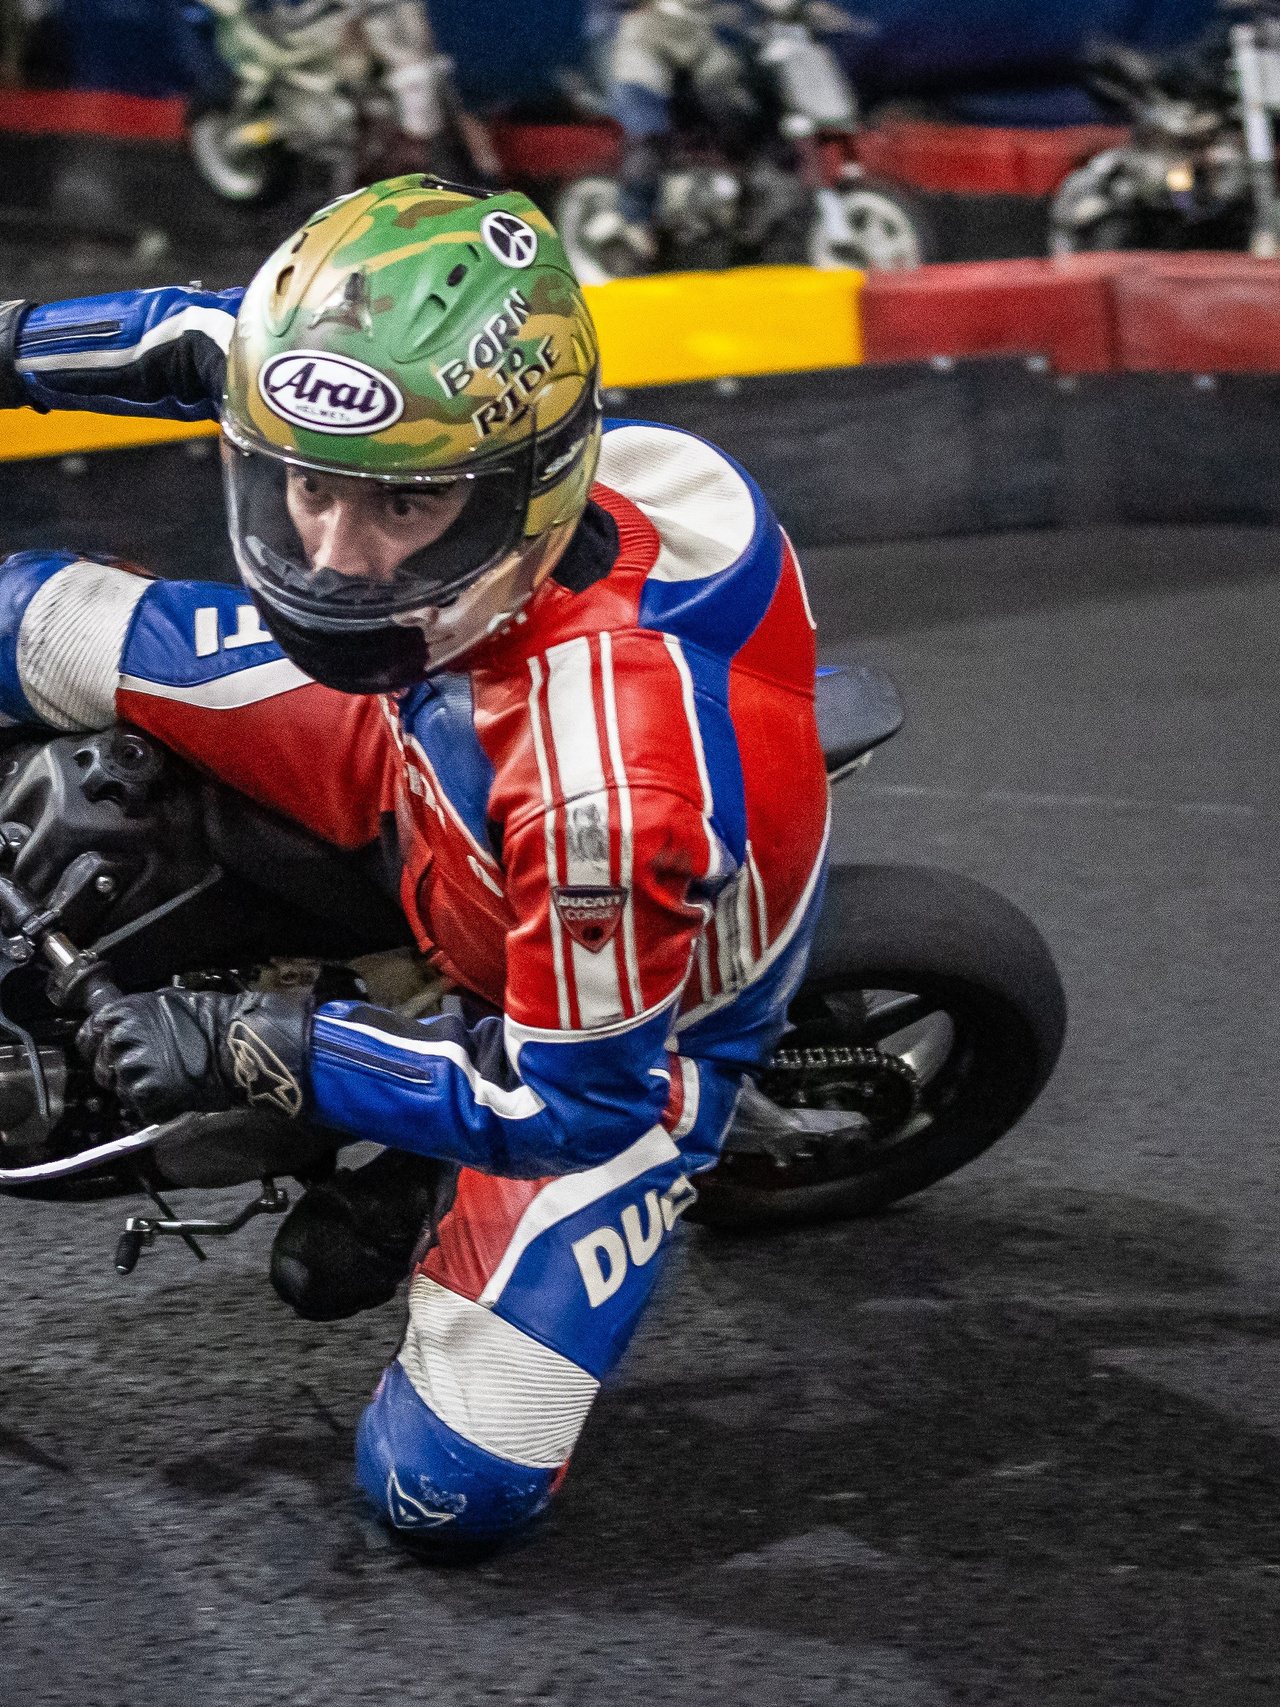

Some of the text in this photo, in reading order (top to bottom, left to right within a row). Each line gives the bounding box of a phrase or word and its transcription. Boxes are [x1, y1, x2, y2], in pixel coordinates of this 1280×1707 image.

[435, 287, 532, 399] BORN
[487, 347, 524, 387] TO
[269, 362, 377, 413] Arai
[471, 335, 561, 438] RIDE
[558, 895, 621, 908] DUCATI
